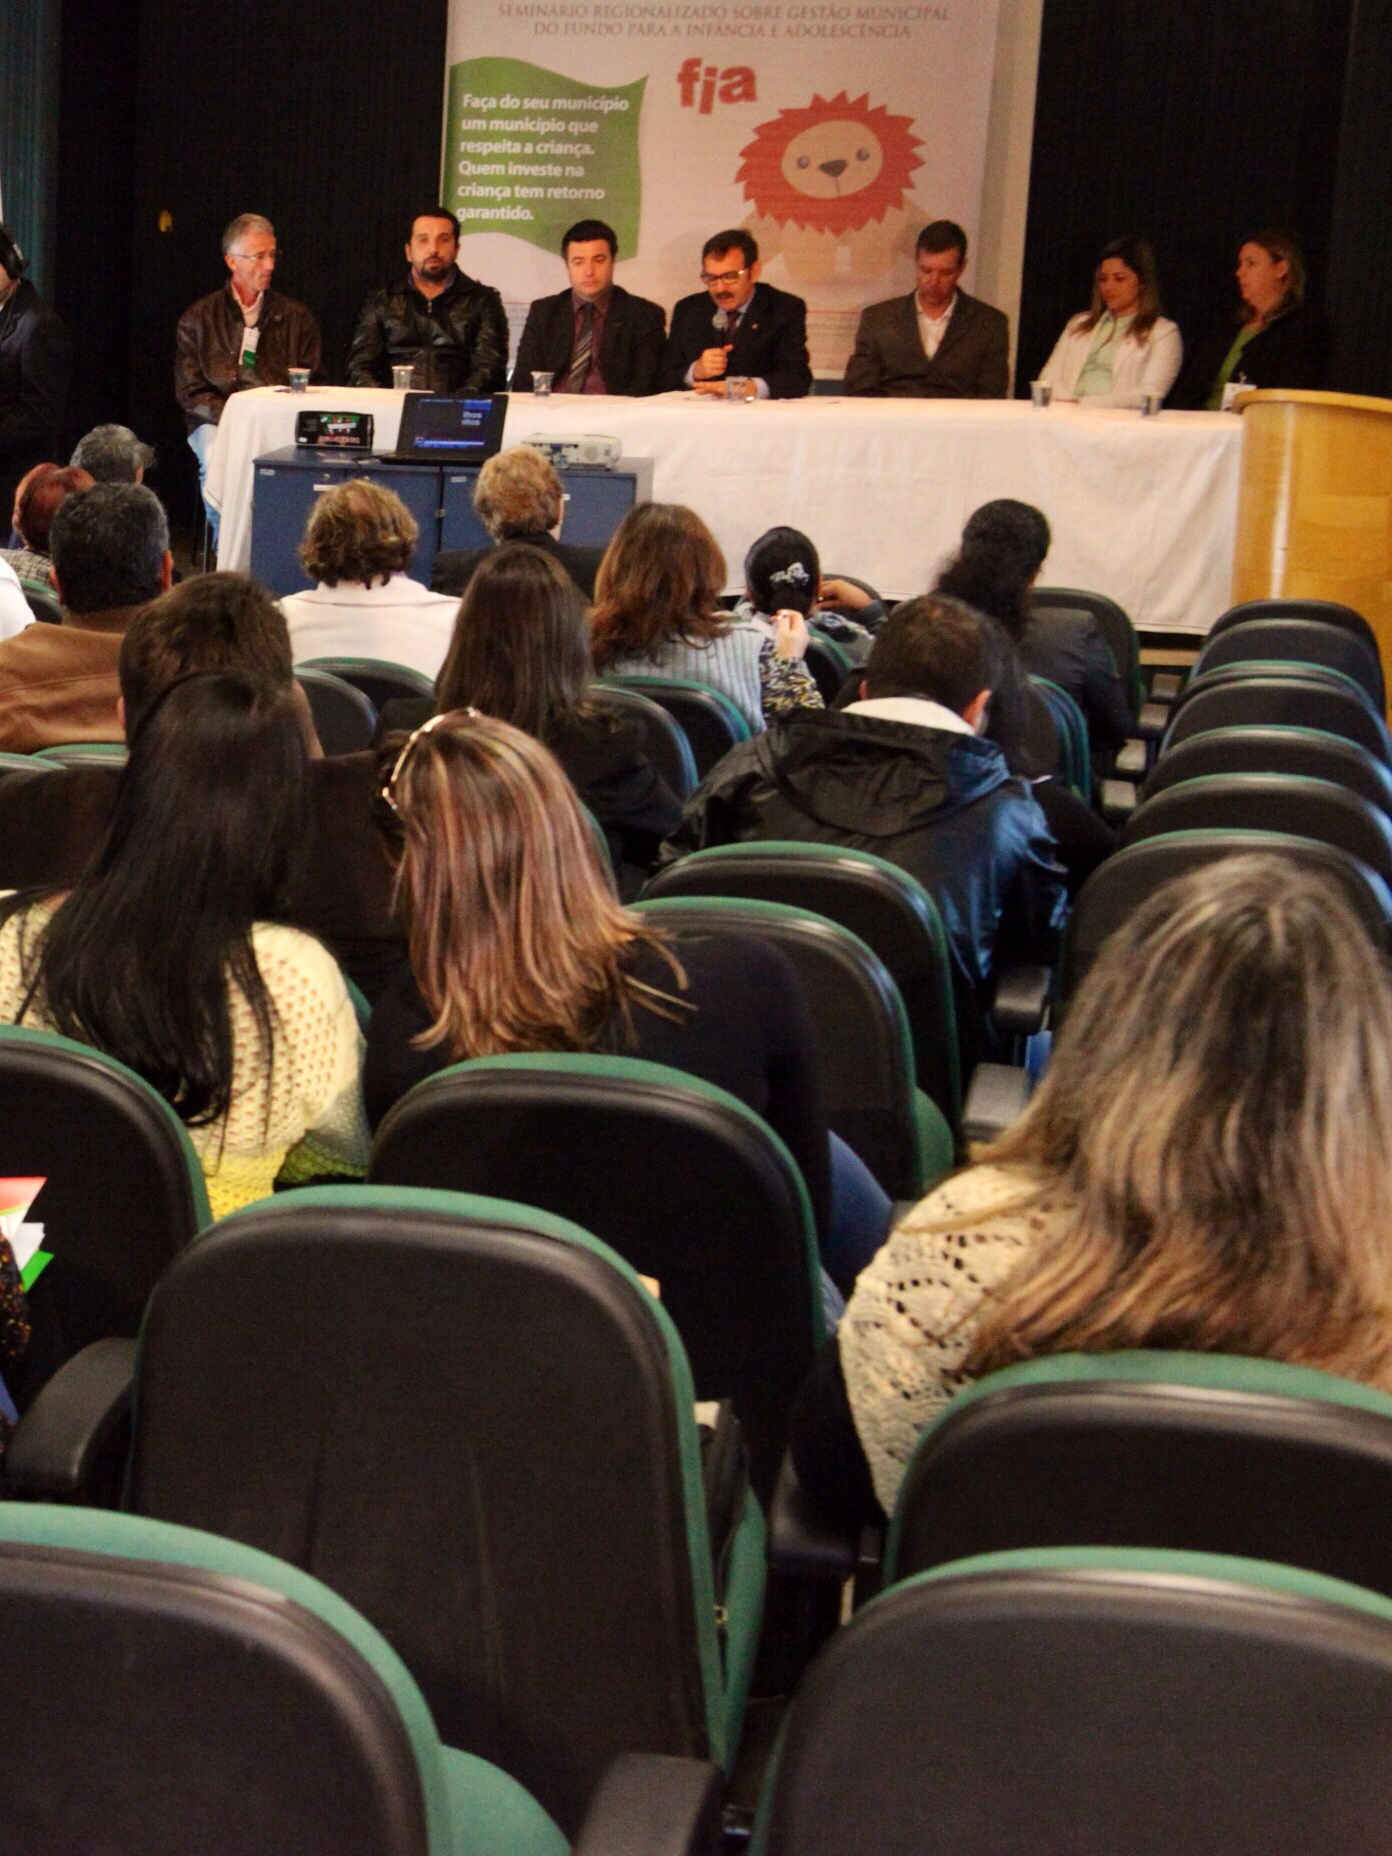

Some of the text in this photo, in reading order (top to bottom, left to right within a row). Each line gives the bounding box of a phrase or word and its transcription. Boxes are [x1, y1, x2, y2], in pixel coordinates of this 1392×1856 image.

[593, 5, 728, 19] REGIONALIZADO
[733, 6, 782, 20] SOBRE
[856, 6, 950, 20] MUNICIPAL
[534, 21, 559, 36] DO
[564, 22, 623, 37] FUNDO
[628, 23, 666, 37] PARA
[671, 24, 681, 37] A
[463, 93, 497, 112] Faça
[500, 94, 520, 108] do
[523, 98, 549, 109] seu
[461, 118, 486, 130] um
[568, 121, 599, 135] que
[460, 138, 595, 158] respeita a criança.
[459, 160, 585, 178] Quem investe na
[457, 182, 606, 201] criança tem retorno
[455, 205, 535, 222] garantido.
